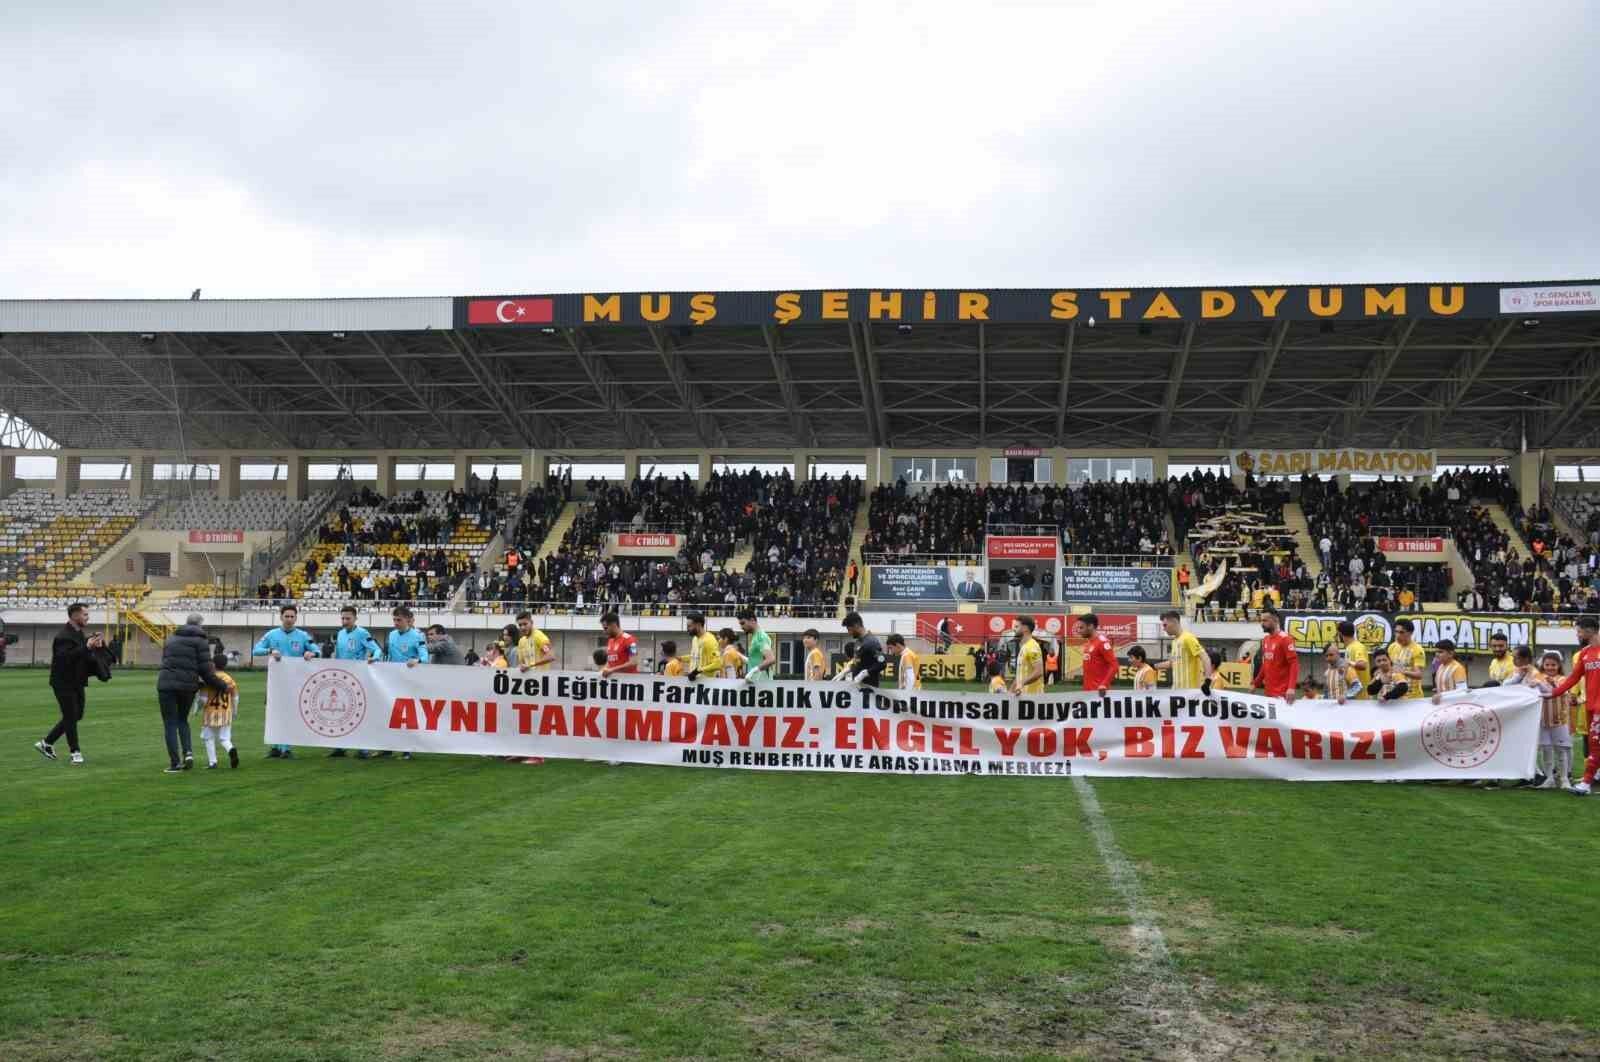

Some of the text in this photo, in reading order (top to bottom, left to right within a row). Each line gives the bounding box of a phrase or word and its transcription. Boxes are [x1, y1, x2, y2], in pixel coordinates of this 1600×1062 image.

[584, 287, 1465, 325] MUŞ ŞEHİR STADYUMU
[1259, 451, 1433, 472] SARI MARATON
[1288, 619, 1345, 649] SAR
[493, 669, 1277, 723] Özel Eğitim Farkındalık ve Toplumsal Duyarlılık Projesi
[389, 697, 498, 734] AYNI
[512, 703, 820, 750] TAKIMDAYIZ:
[835, 716, 981, 757] ENGEL
[994, 727, 1107, 762] YOK,
[1123, 720, 1206, 759] BİZ
[1219, 726, 1397, 760] VARIZ!
[683, 749, 1073, 776] MUŞ REHBERLİK VE ARAŞTIRMA MERKEZİ
